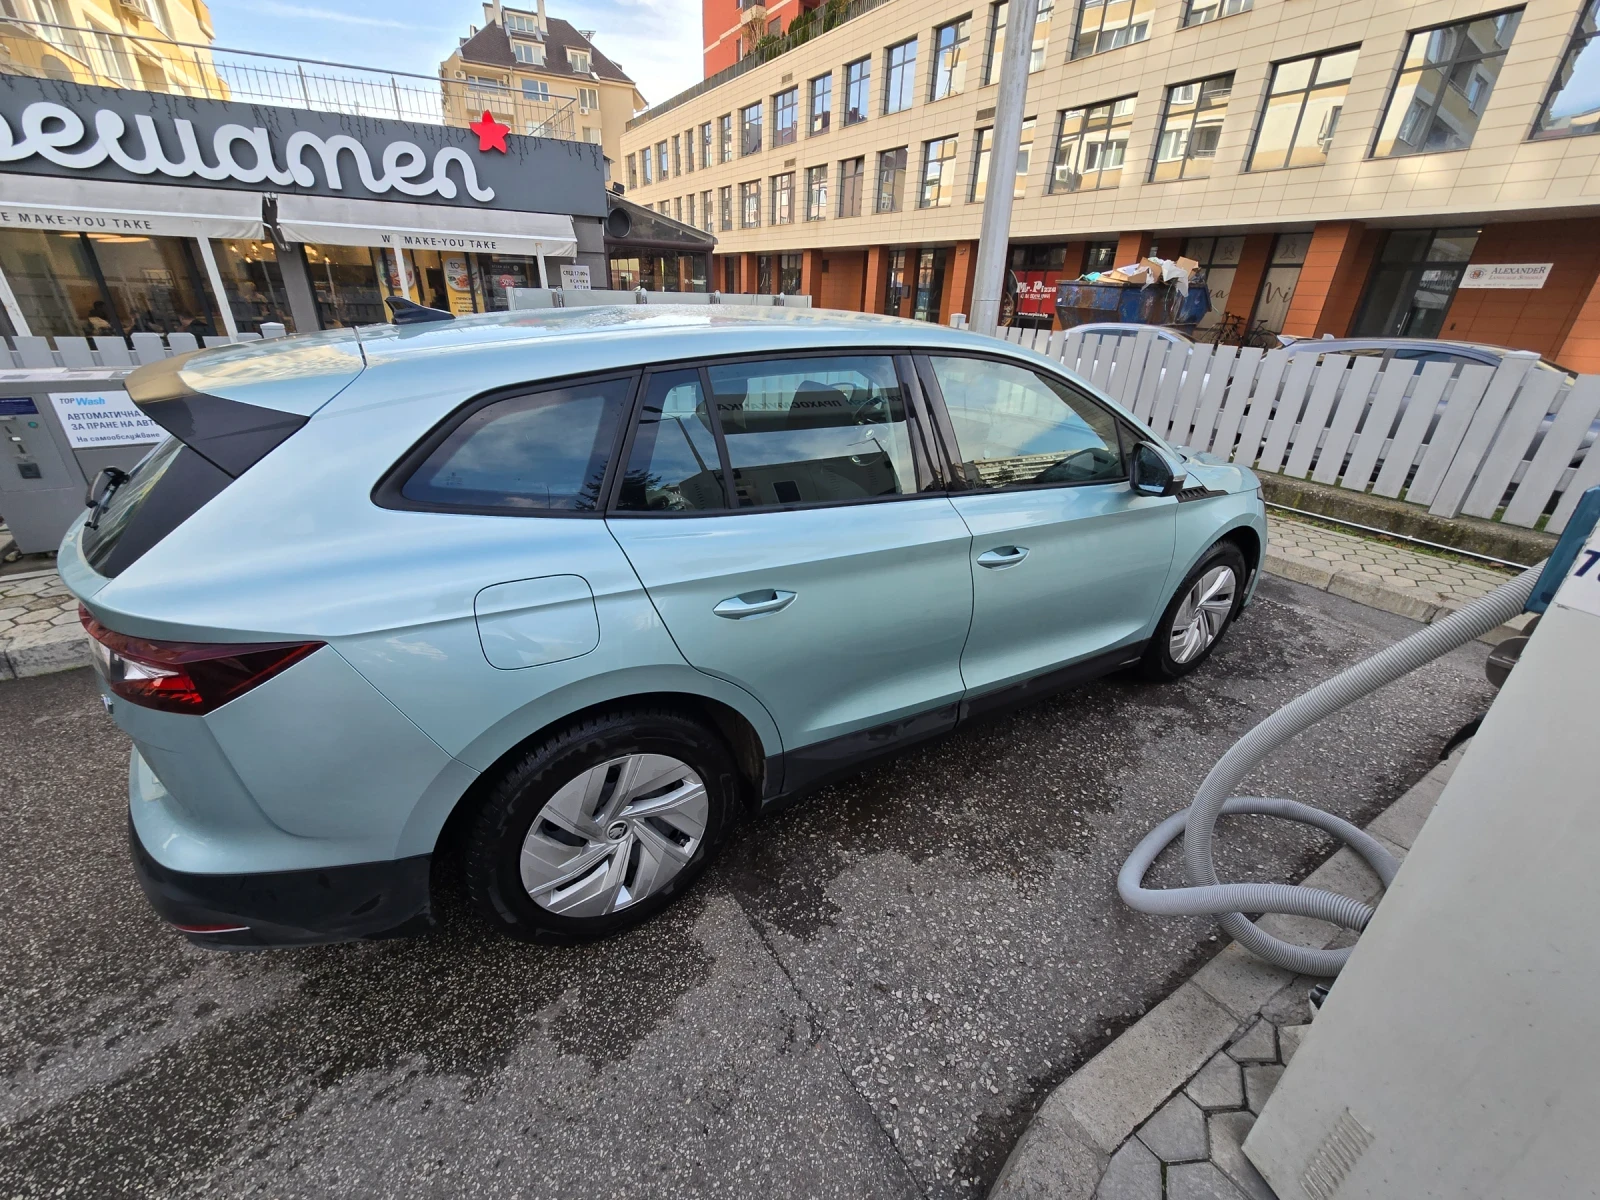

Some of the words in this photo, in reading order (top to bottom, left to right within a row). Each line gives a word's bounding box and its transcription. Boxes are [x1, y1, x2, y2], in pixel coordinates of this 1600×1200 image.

[18, 212, 106, 227] MAKE-YOU
[112, 218, 153, 230] TAKE
[381, 235, 391, 243] W
[404, 236, 465, 247] MAKE-YOU
[470, 240, 497, 249] TAKE
[1491, 266, 1546, 274] ALEXANDER
[67, 410, 142, 421] АВТОМАТИЧНА
[71, 423, 85, 431] ЗА
[86, 422, 119, 430] ПРАНЕ
[90, 432, 160, 442] самообслужване
